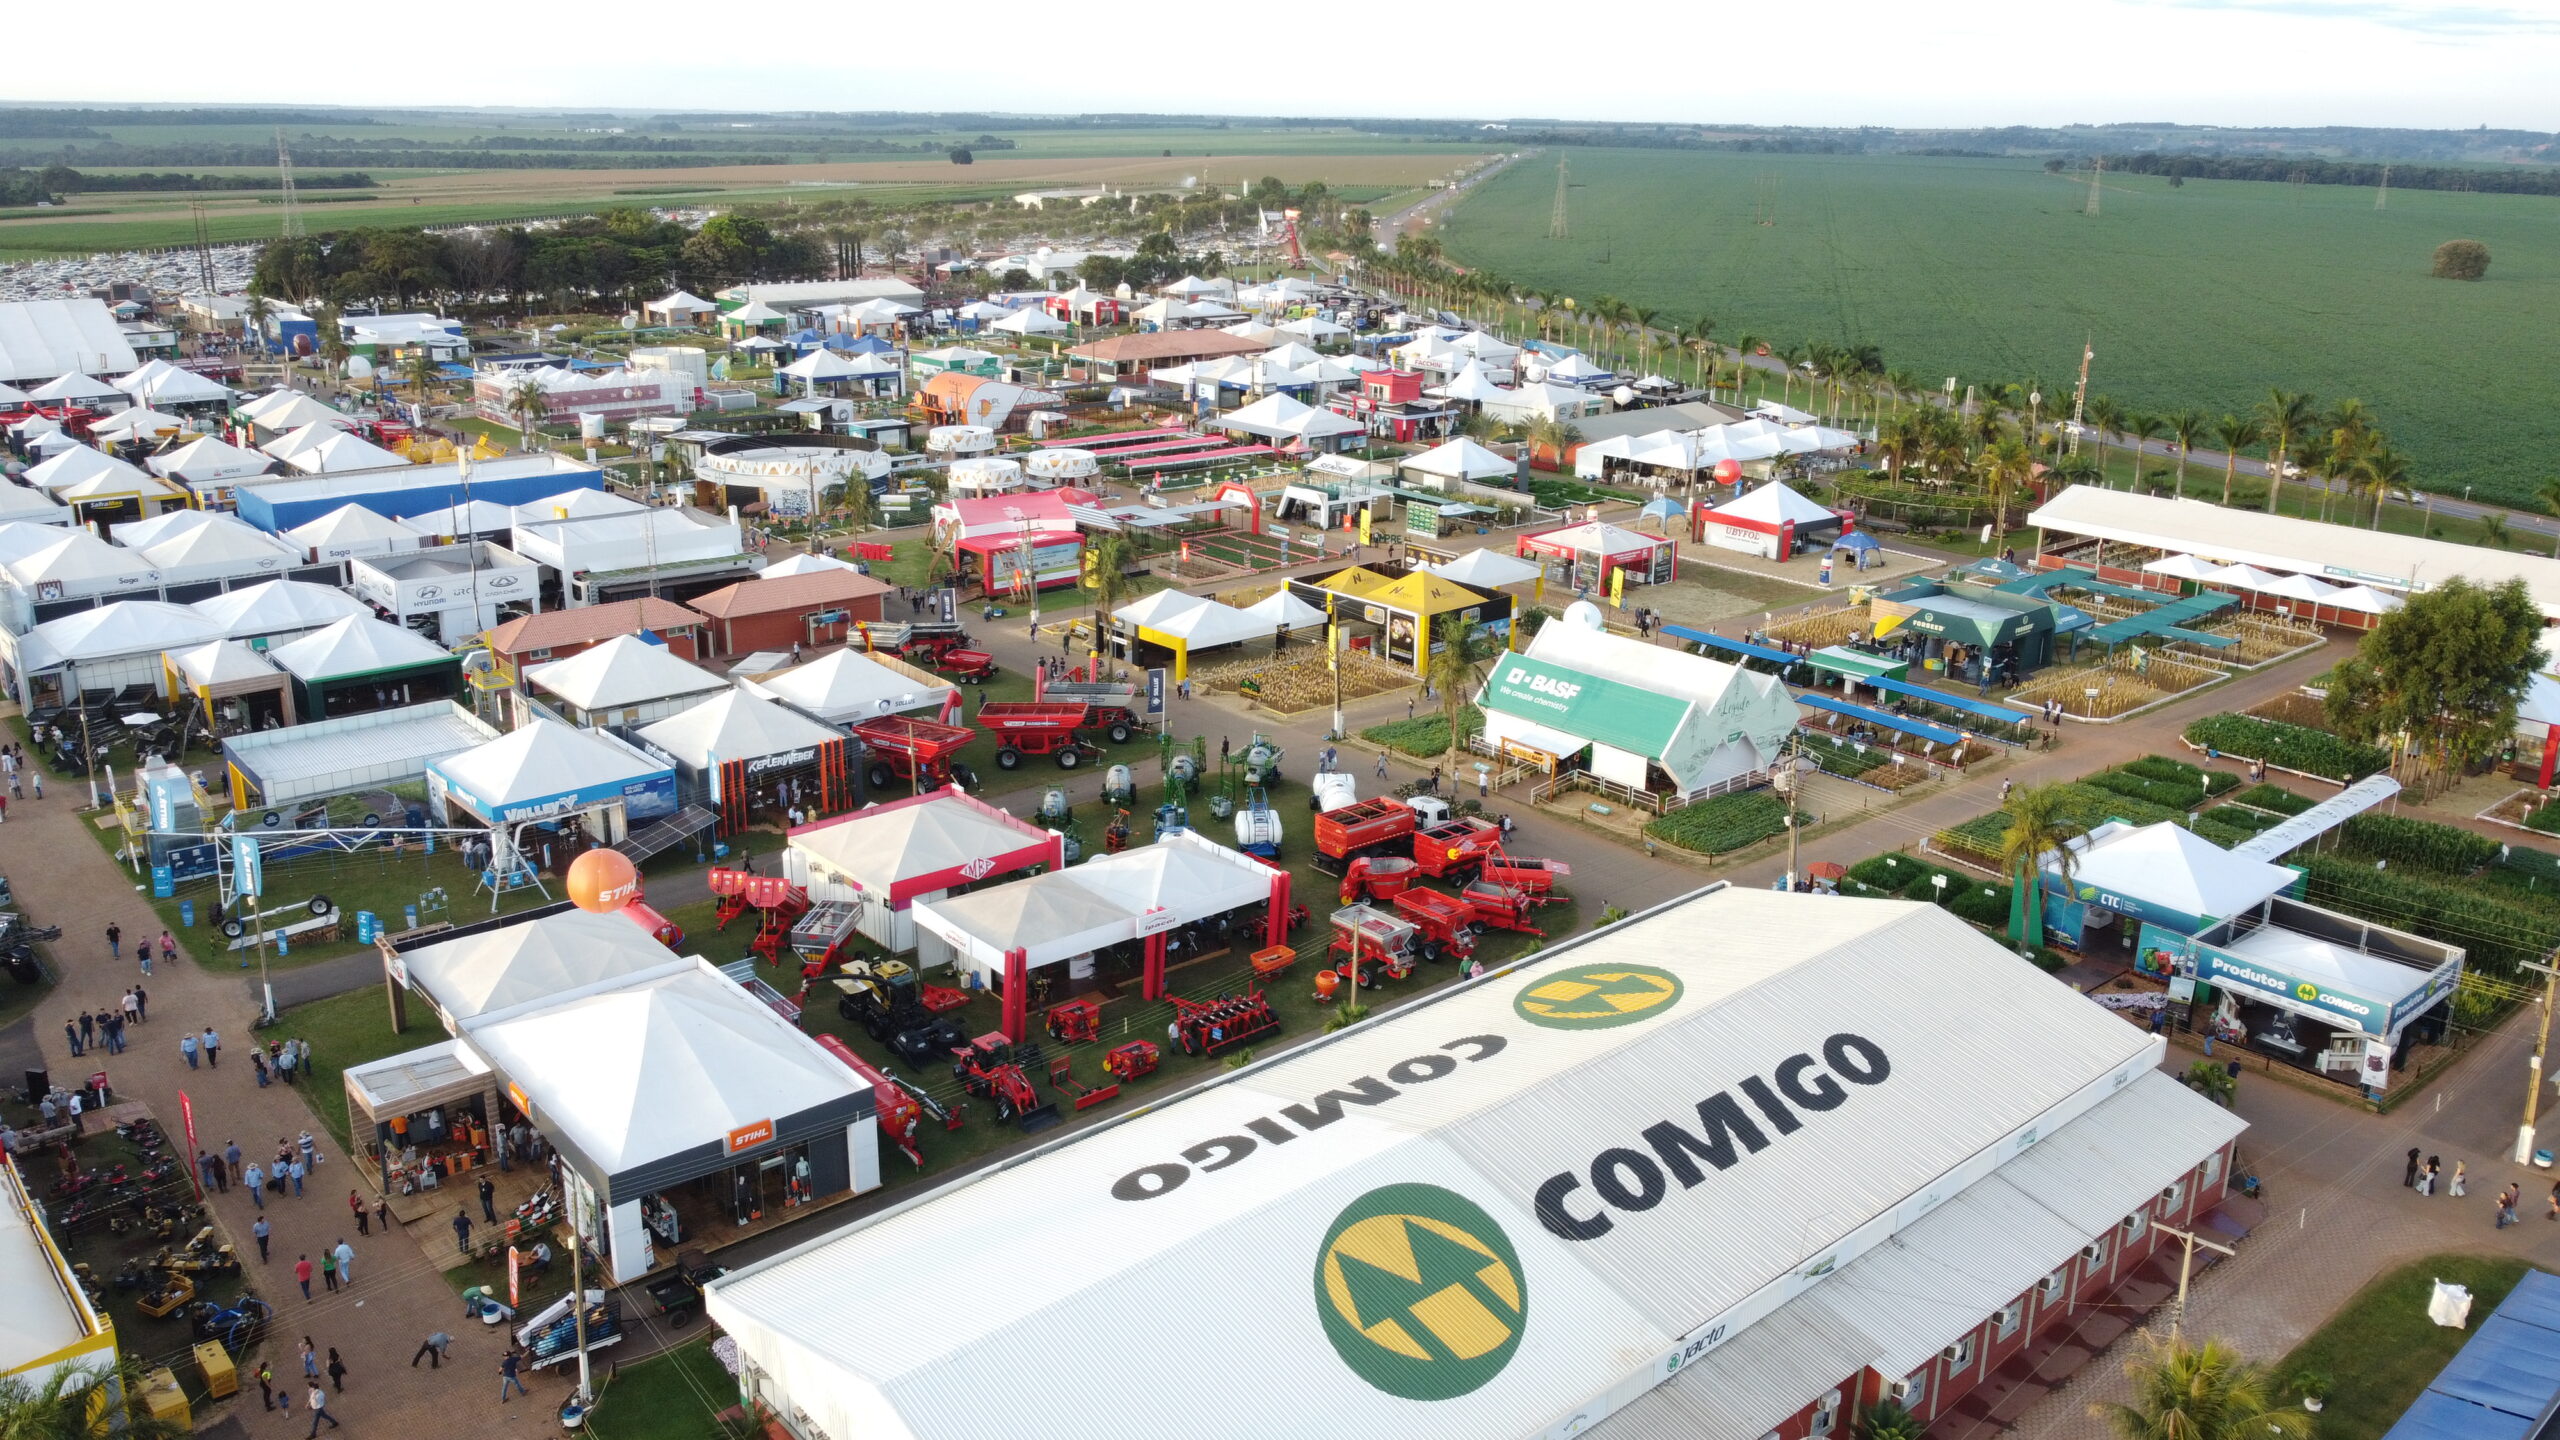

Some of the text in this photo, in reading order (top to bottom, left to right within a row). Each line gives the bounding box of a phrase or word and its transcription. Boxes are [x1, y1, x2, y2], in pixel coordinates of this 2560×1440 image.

[329, 549, 351, 558] Saga
[119, 576, 140, 585] Saga
[414, 597, 447, 608] HYUNDAI
[1913, 619, 1945, 632] FORSEED
[1530, 674, 1582, 700] BASF
[895, 698, 916, 707] SOLLUS
[1500, 685, 1569, 713] We create chemistry
[599, 877, 637, 902] STIH
[2101, 893, 2121, 909] CTC
[2212, 957, 2370, 1016] Produtos COMIGO
[1109, 1033, 1509, 1202] COMIGO
[735, 1129, 769, 1146] STIHL
[1533, 1033, 1892, 1242] COMIGO
